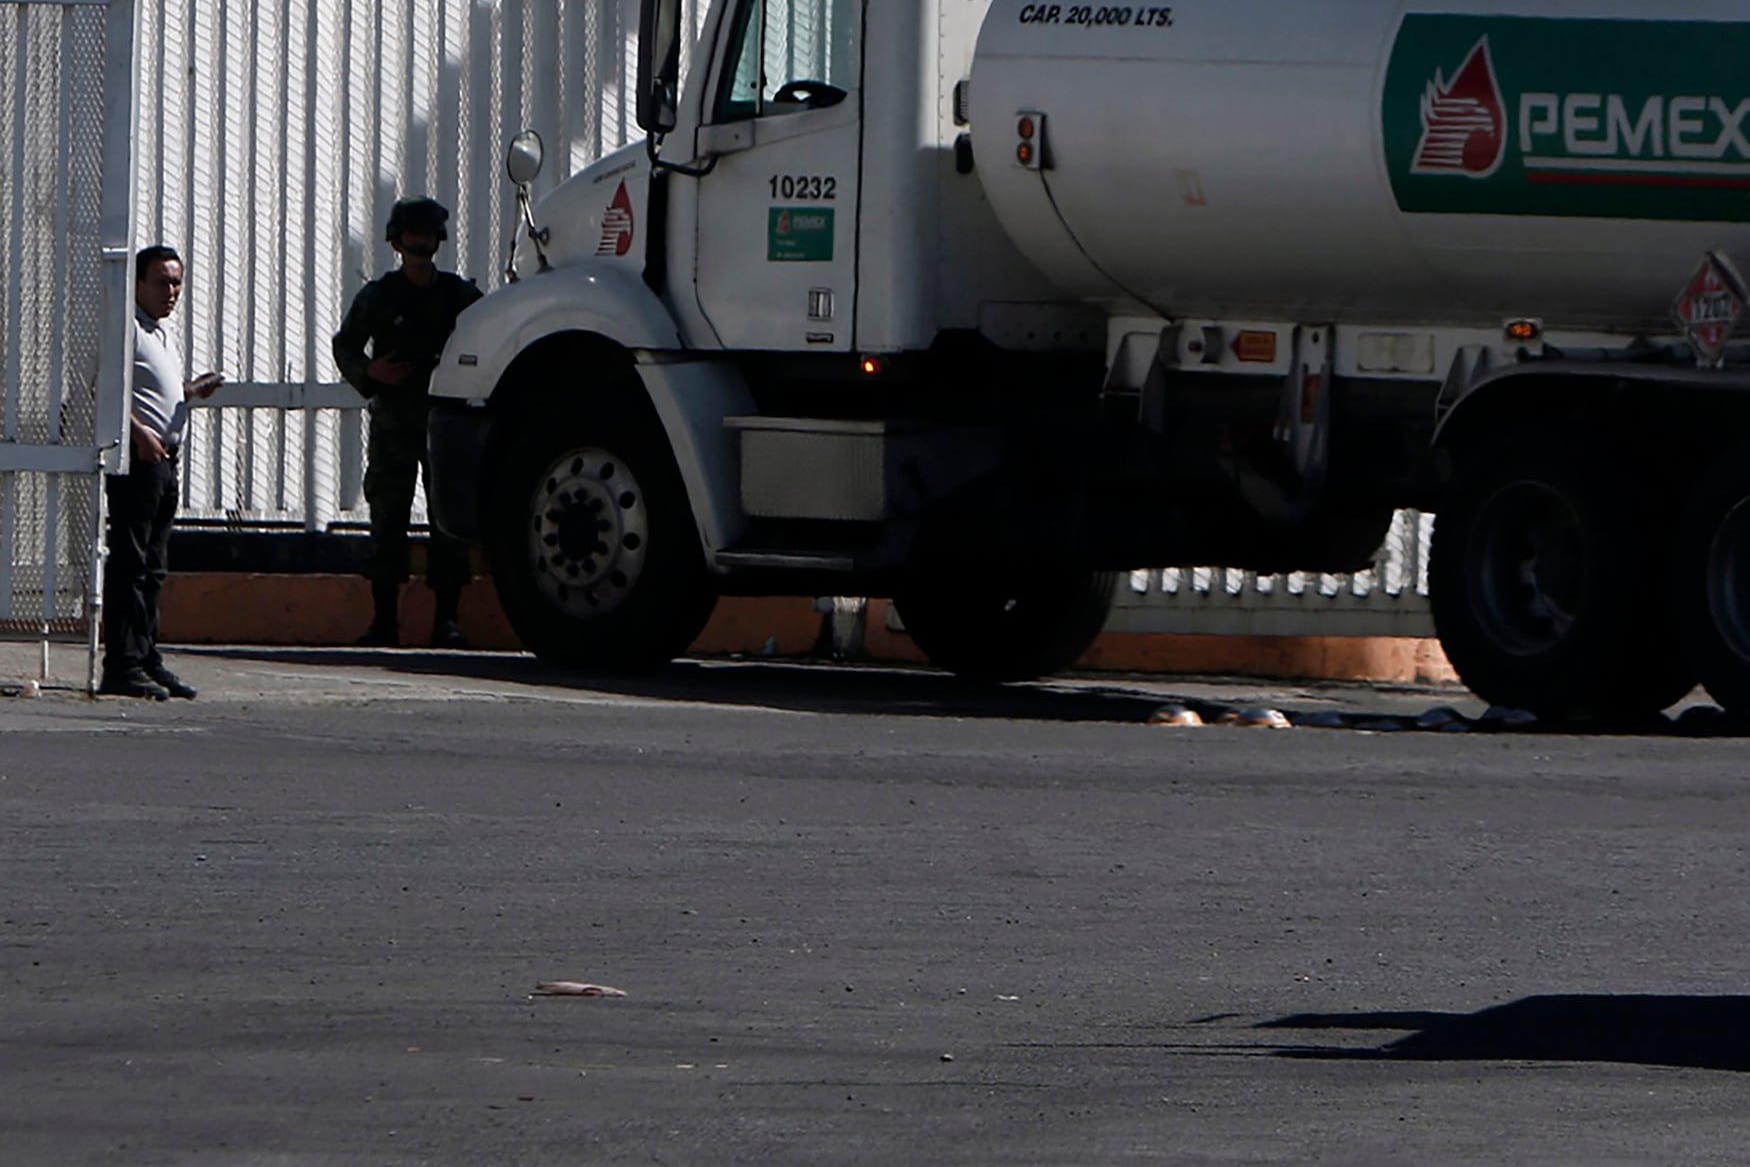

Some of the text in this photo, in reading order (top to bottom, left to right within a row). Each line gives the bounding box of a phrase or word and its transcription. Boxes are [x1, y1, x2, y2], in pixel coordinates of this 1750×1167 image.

[1019, 4, 1174, 28] CAP. 20,000 LTS.
[769, 175, 837, 200] 10232
